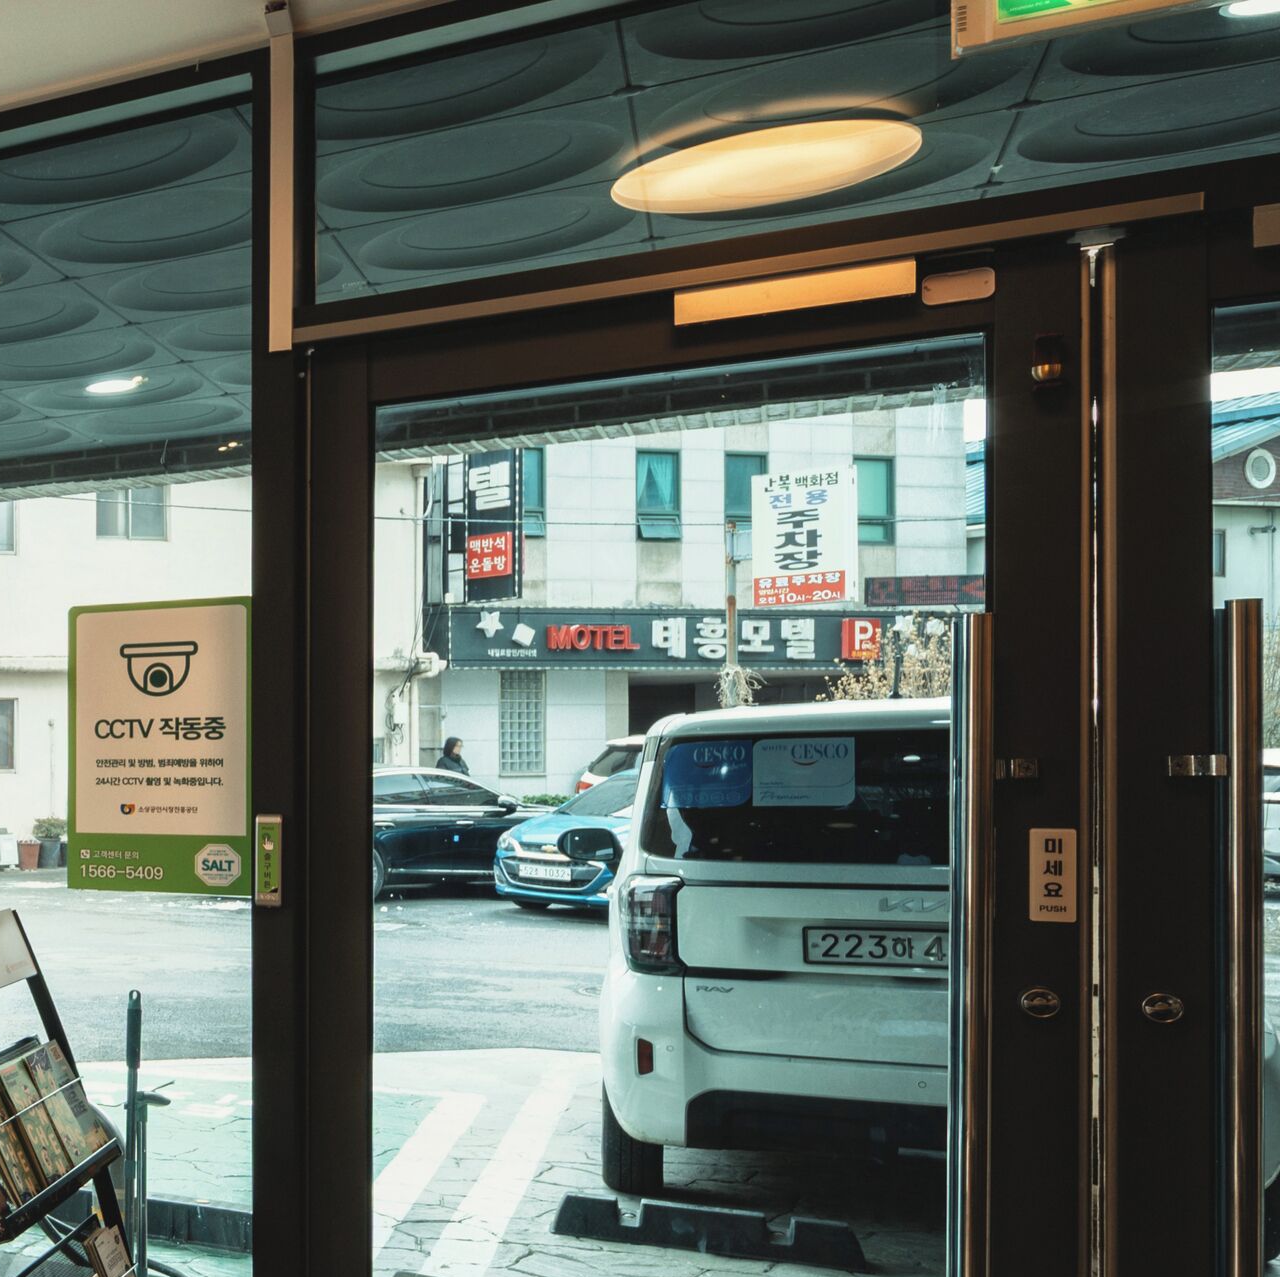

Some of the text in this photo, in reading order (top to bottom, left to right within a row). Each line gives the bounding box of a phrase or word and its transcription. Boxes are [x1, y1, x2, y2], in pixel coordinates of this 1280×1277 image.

[469, 461, 511, 510] 텔
[795, 471, 839, 488] 백화점
[469, 536, 506, 554] 맥반석
[774, 508, 822, 570] 주차장
[469, 555, 506, 574] 온돌방
[758, 572, 841, 589] 유료주차장
[546, 624, 640, 650] MOTEL
[854, 620, 874, 650] P
[95, 716, 226, 741] CCTV 작동중
[693, 745, 745, 764] CESCO
[791, 743, 849, 760] CESCO
[96, 758, 125, 768] 안전관리
[128, 758, 136, 768] 및
[158, 758, 197, 768] 범죄예방을
[199, 758, 224, 768] 위하여
[96, 777, 120, 786] 24시간
[122, 777, 144, 786] CCTV
[146, 777, 161, 786] 촬영
[164, 777, 171, 786] 및
[93, 850, 139, 860] 고객센터 문의
[80, 864, 164, 881] 1566-5409
[201, 858, 235, 872] SALT
[1042, 838, 1063, 898] 미세요
[1039, 904, 1067, 913] PUSH
[821, 934, 914, 959] 223하
[696, 985, 734, 993] RAY
